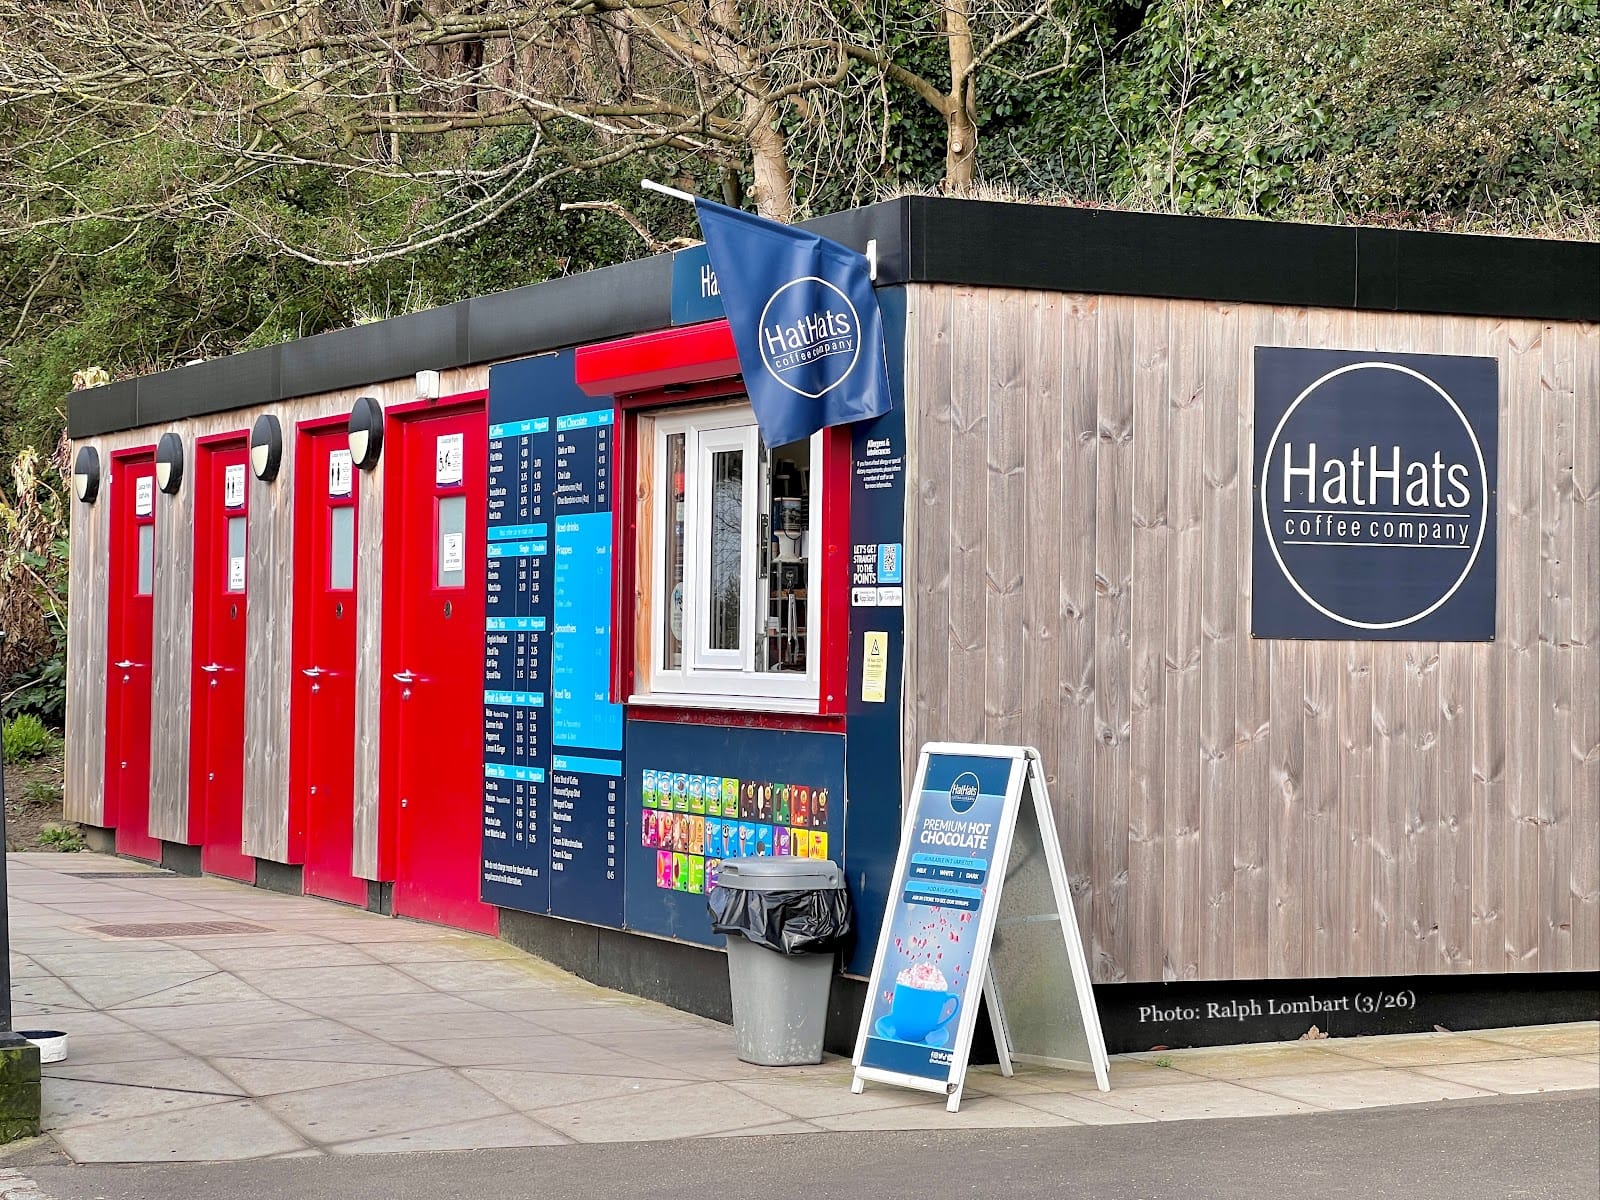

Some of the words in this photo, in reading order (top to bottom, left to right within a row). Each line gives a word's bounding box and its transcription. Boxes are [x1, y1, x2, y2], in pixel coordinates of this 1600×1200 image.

[765, 310, 851, 355] HatHats
[776, 351, 812, 368] coffee
[812, 340, 852, 356] company
[490, 424, 504, 437] Coffee
[558, 418, 566, 430] Hot
[567, 415, 588, 428] Chocolate
[1283, 443, 1470, 508] HatHats
[1285, 514, 1361, 537] coffee
[1370, 520, 1470, 544] company
[867, 544, 877, 554] GET
[853, 554, 877, 564] STRAIGHT
[856, 564, 864, 573] TO
[864, 564, 873, 573] THE
[853, 573, 876, 584] POINTS
[923, 818, 967, 832] PREMIUM
[968, 822, 992, 836] HOT
[920, 830, 989, 850] CHOCOLATE
